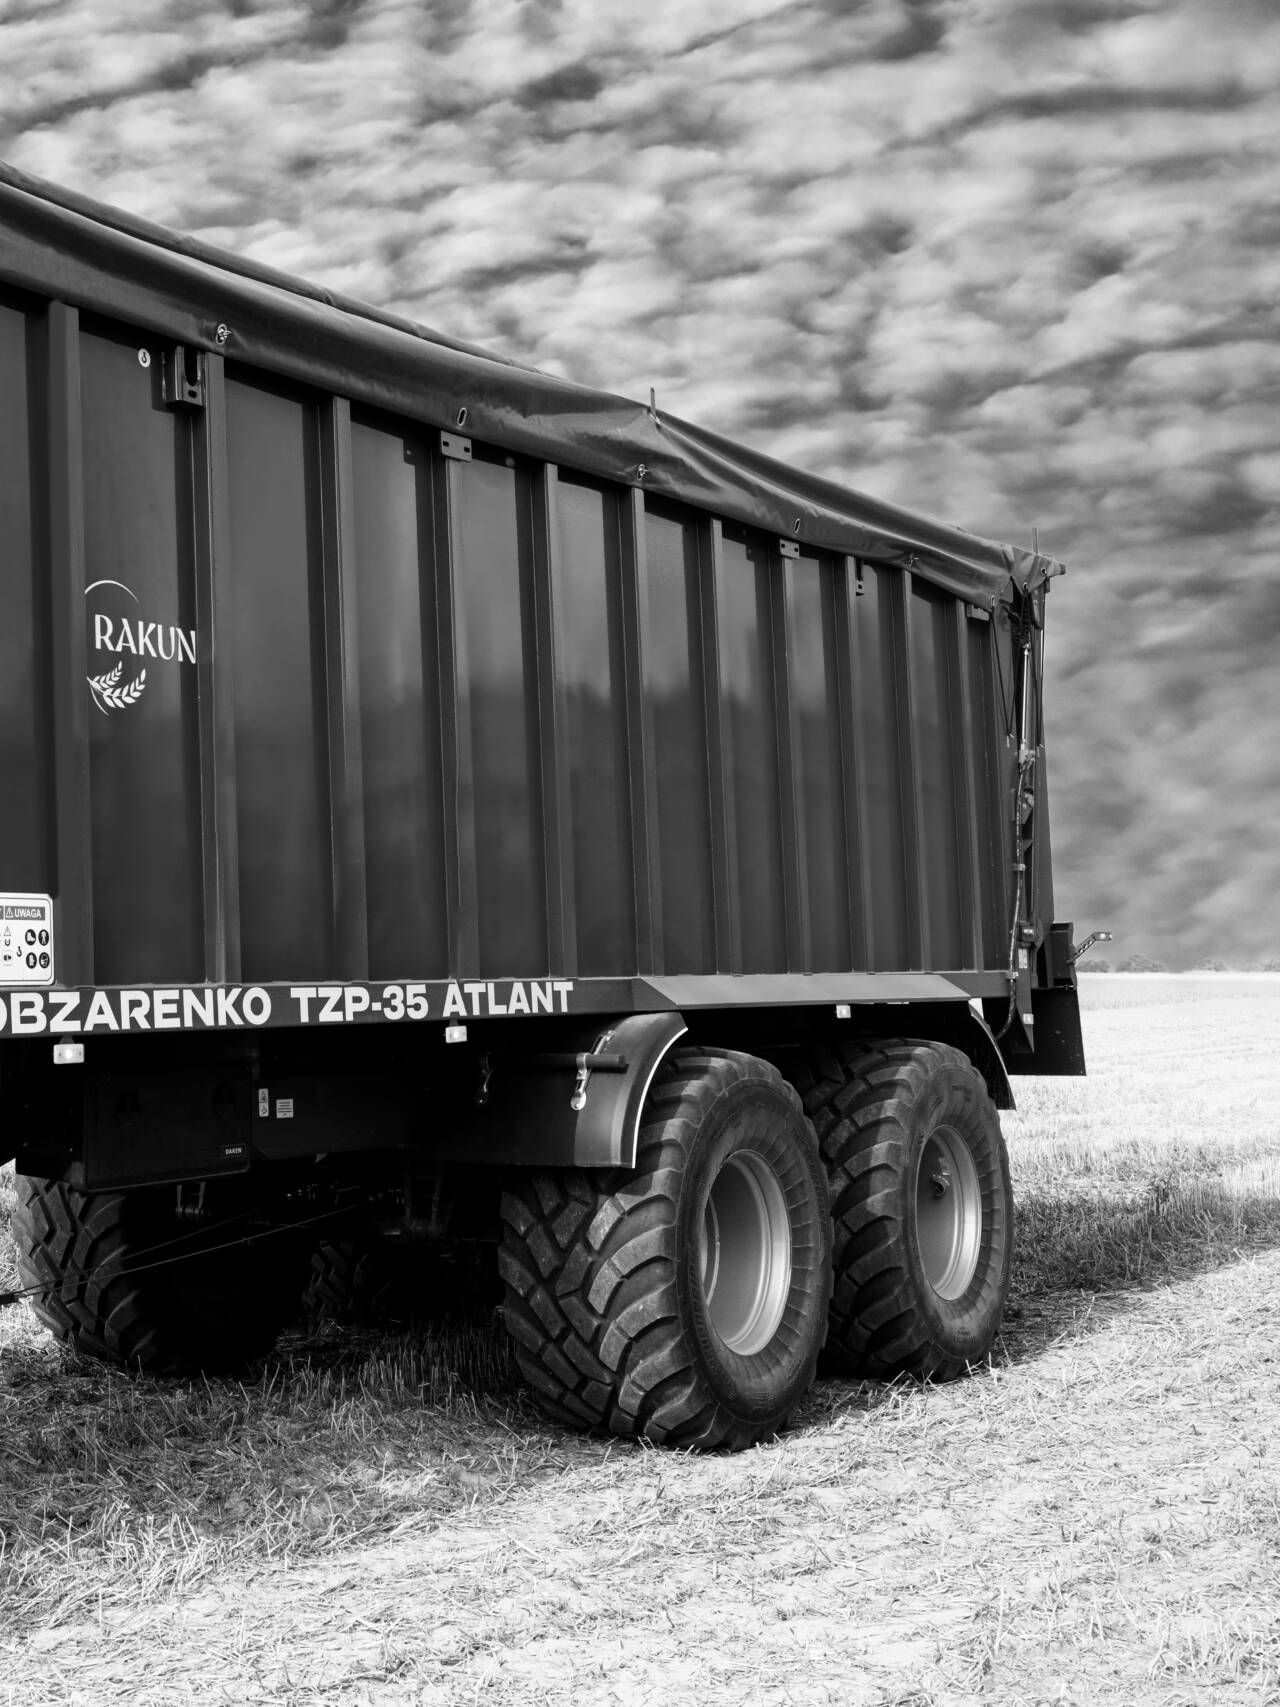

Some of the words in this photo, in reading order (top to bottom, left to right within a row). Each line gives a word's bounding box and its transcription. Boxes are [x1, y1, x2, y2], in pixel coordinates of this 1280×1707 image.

[94, 614, 196, 664] RAKUN
[14, 908, 42, 918] UWAGA
[290, 983, 429, 1023] TZP-35
[442, 980, 574, 1018] ATLANT
